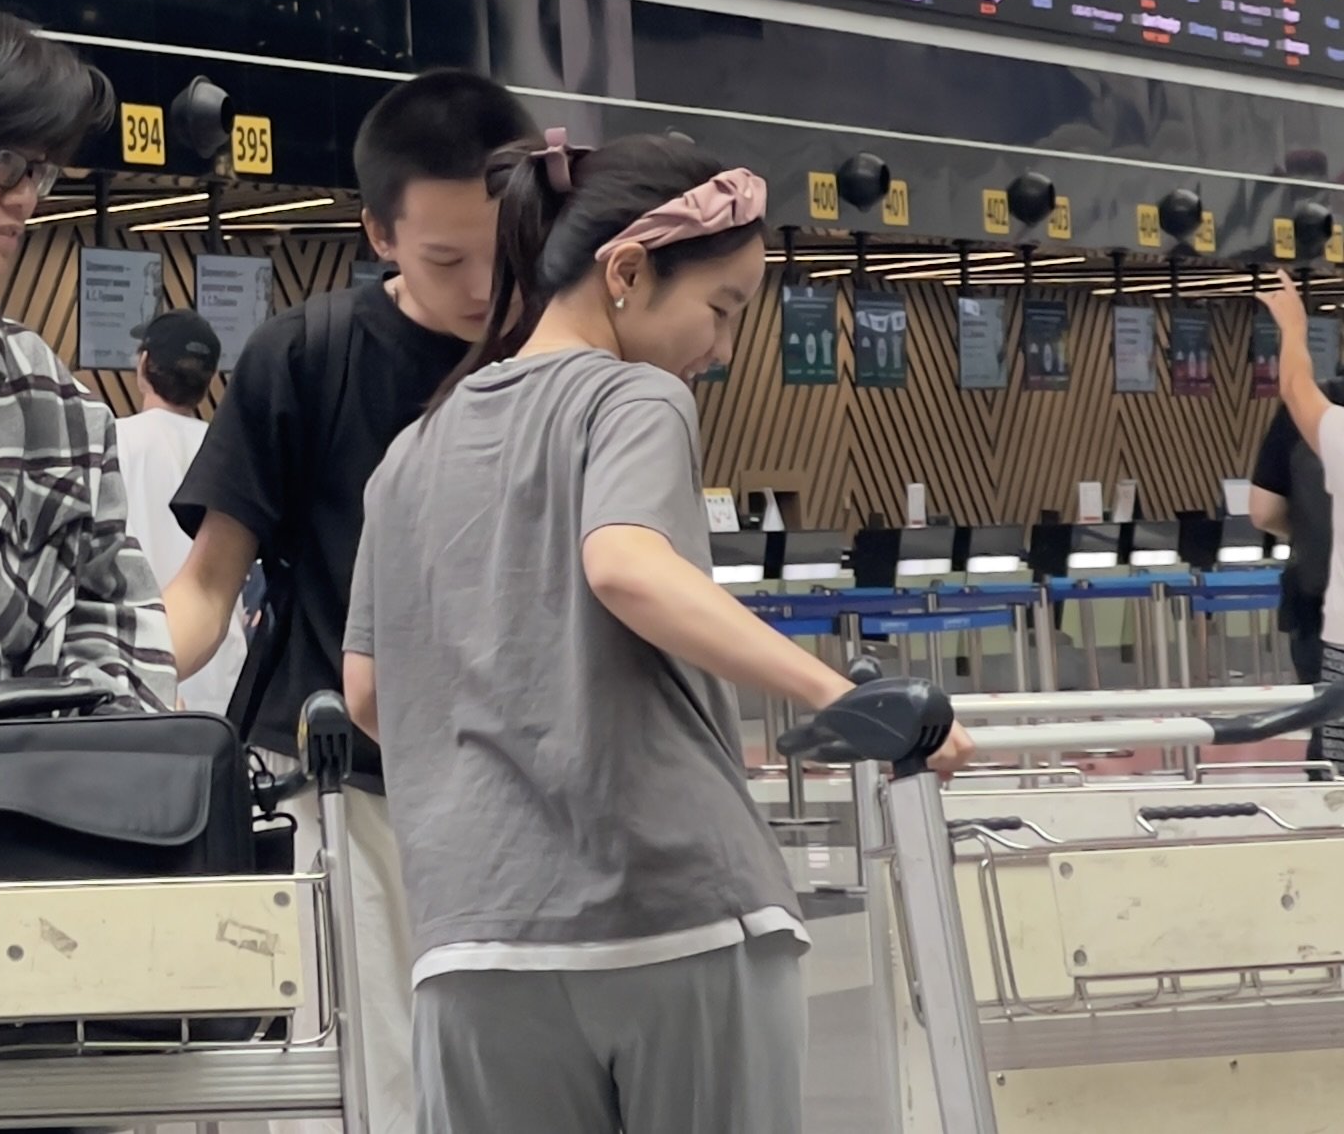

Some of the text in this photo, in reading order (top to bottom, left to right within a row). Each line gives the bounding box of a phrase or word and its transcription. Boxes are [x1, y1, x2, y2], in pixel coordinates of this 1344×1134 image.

[126, 115, 162, 154] 394
[237, 126, 270, 163] 395
[813, 180, 837, 212] 400
